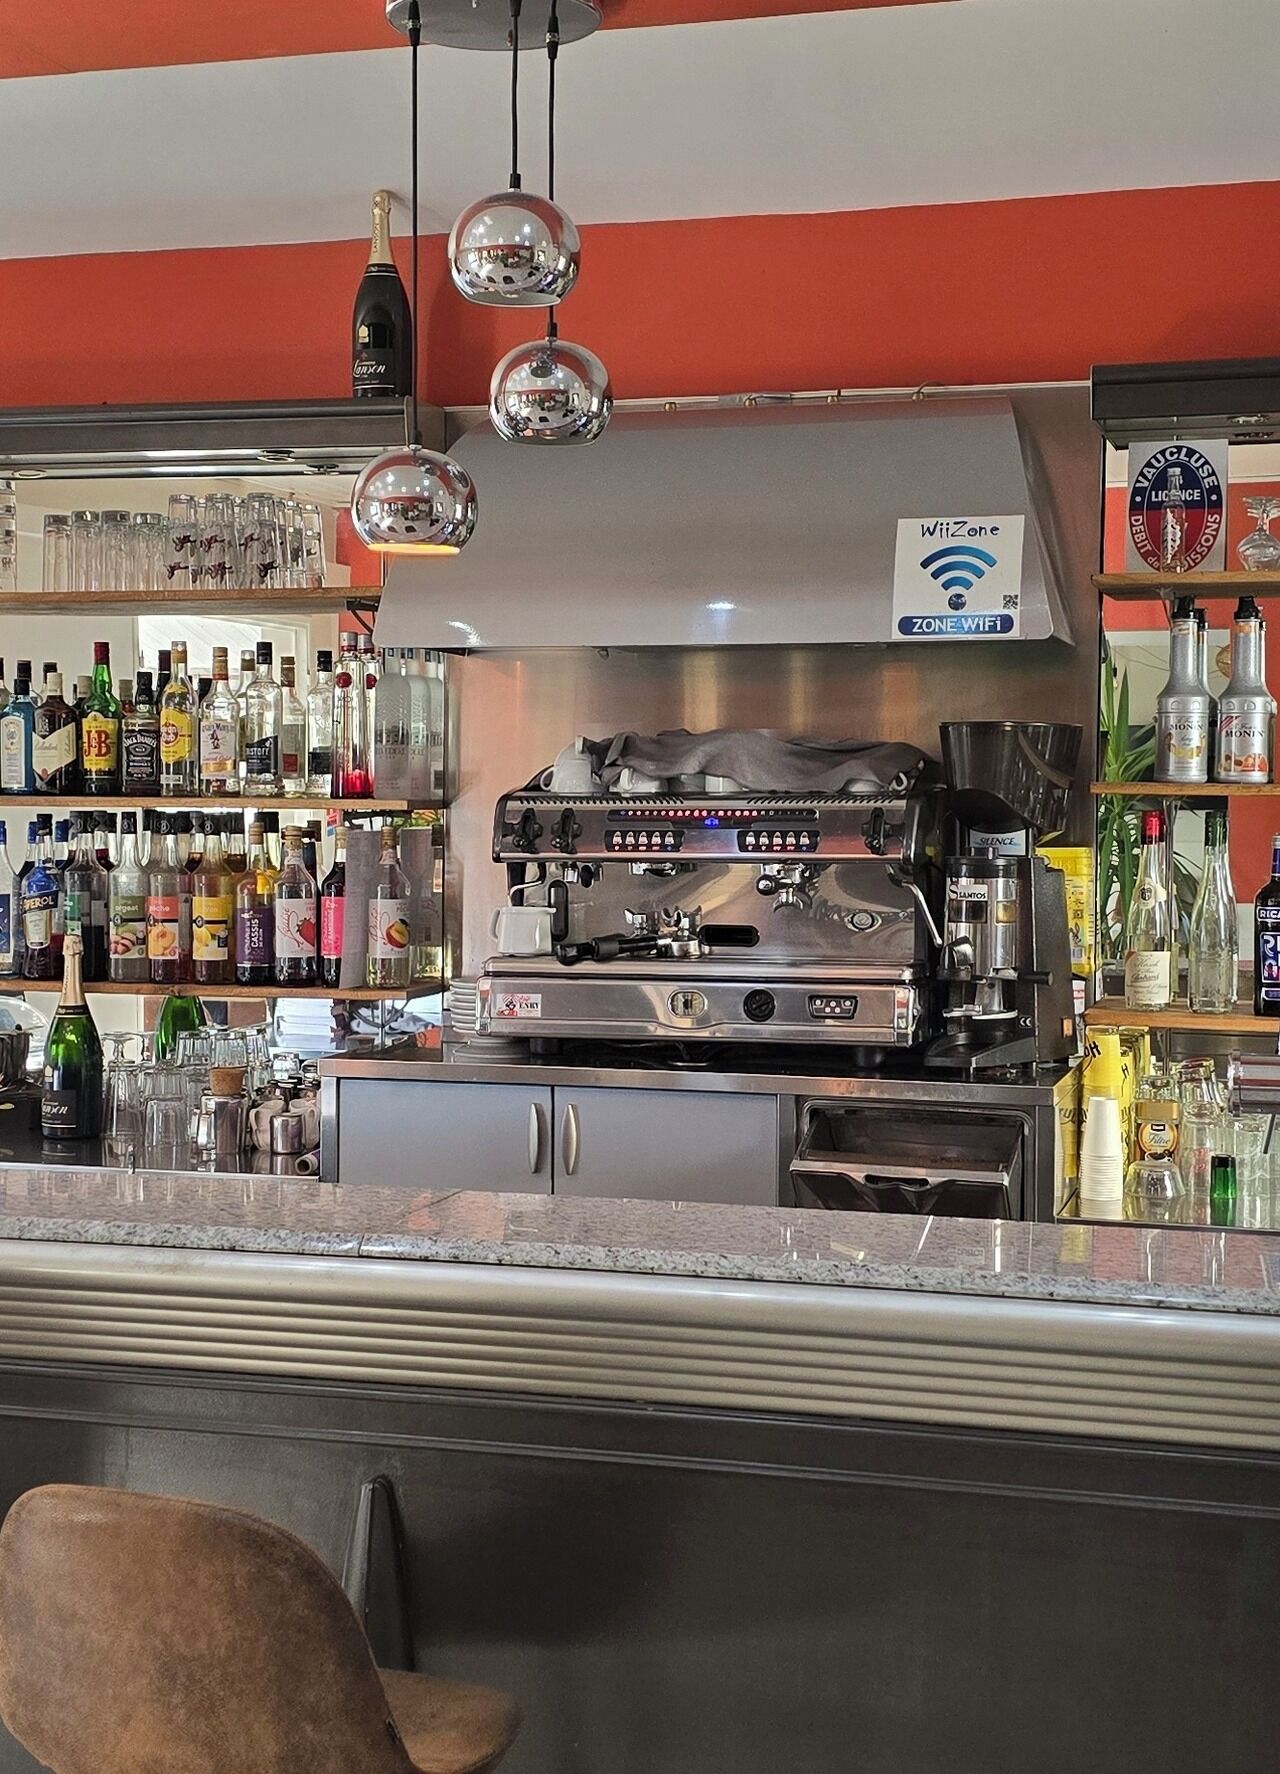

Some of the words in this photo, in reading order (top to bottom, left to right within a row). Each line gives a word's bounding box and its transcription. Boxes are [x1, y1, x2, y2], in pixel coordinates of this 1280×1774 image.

[1135, 447, 1218, 489] VAUCLUSE
[1151, 489, 1201, 502] LICNCE
[921, 520, 1000, 539] WiiZone
[1131, 515, 1152, 553] DEBIT
[912, 618, 958, 633] ZONE
[1224, 729, 1265, 738] MONIN
[979, 837, 1015, 846] SILENCE
[251, 918, 259, 948] CASSIS
